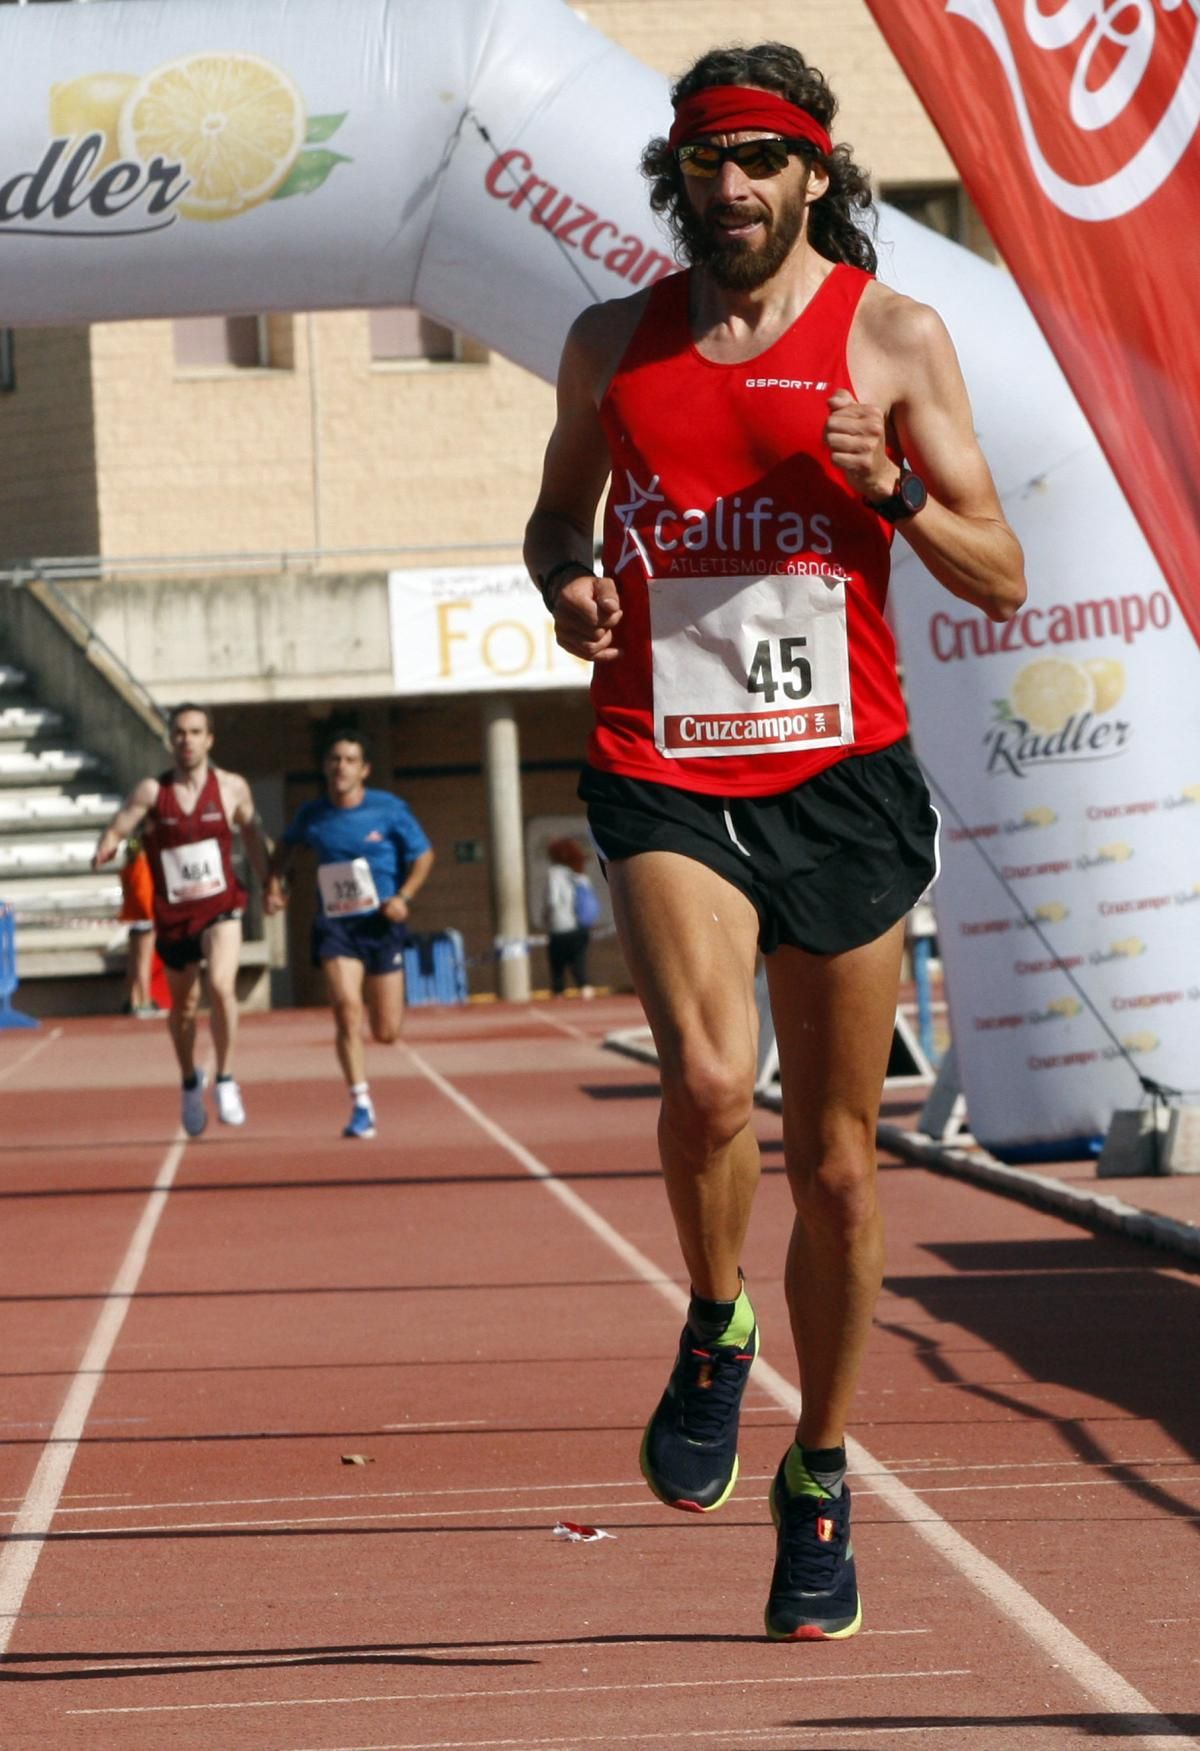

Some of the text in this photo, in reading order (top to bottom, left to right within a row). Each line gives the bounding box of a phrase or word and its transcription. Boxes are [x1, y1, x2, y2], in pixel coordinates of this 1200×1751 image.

[745, 378, 813, 390] GSPORT
[654, 497, 833, 555] califas
[929, 591, 1172, 662] Cruzcampo
[747, 636, 812, 703] 45
[679, 711, 826, 742] Cruzcampo SIN
[984, 711, 1131, 778] Radler
